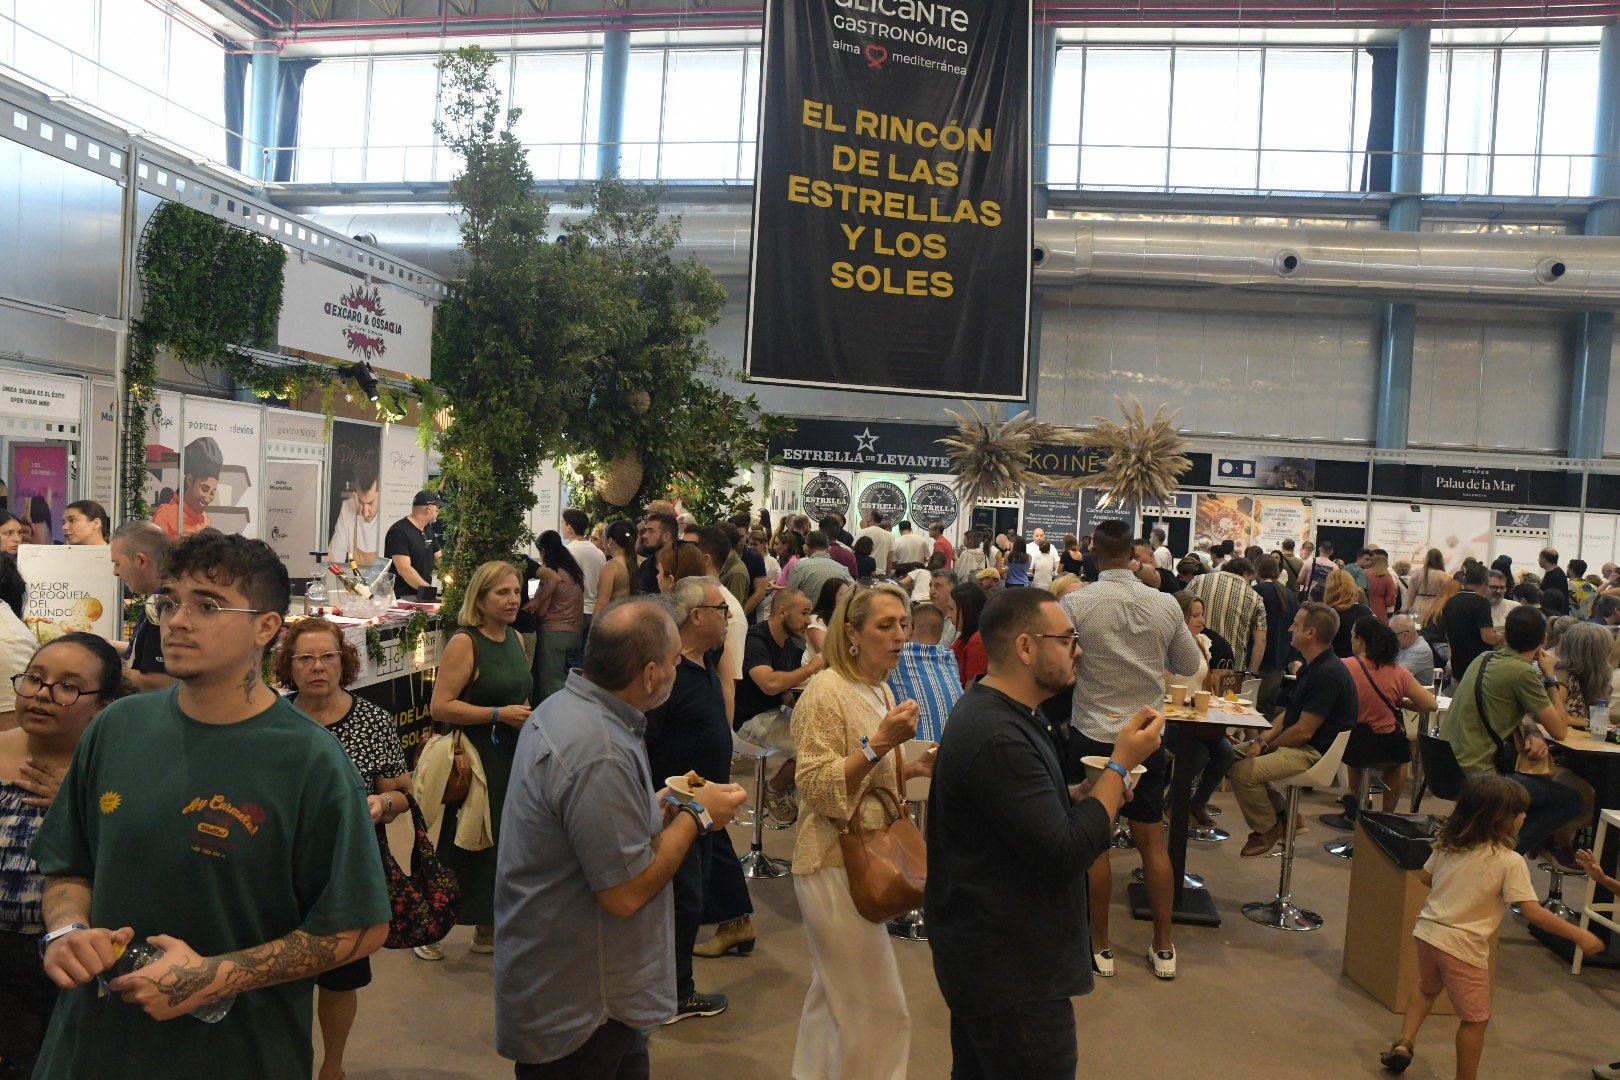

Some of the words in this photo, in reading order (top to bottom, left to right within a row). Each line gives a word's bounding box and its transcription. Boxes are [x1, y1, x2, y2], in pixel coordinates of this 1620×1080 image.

[832, 40, 861, 54] alma
[892, 52, 968, 76] mediterránea
[802, 98, 847, 133] EL
[854, 109, 993, 152] RINCÓN
[832, 144, 880, 177] DE
[888, 153, 960, 188] LAS
[787, 174, 1003, 228] ESTRELLAS
[840, 223, 866, 251] Y
[874, 228, 948, 260] LOS
[830, 261, 955, 298] SOLES
[10, 396, 24, 404] OPEN
[25, 398, 38, 406] YOUR
[782, 448, 864, 463] ESTRELLA
[876, 453, 950, 468] LEVANTE
[1435, 476, 1465, 489] Palau
[1466, 478, 1480, 490] de
[1481, 479, 1491, 491] la
[1492, 479, 1516, 492] Mar
[805, 496, 847, 505] ESTRELLA
[861, 502, 904, 511] ESTRELLA
[912, 504, 955, 512] ESTRELLA
[30, 582, 69, 591] MEJOR
[29, 590, 91, 600] CROQUETA
[29, 599, 49, 609] DEL
[29, 608, 73, 618] MUNDO
[400, 708, 414, 727] DE
